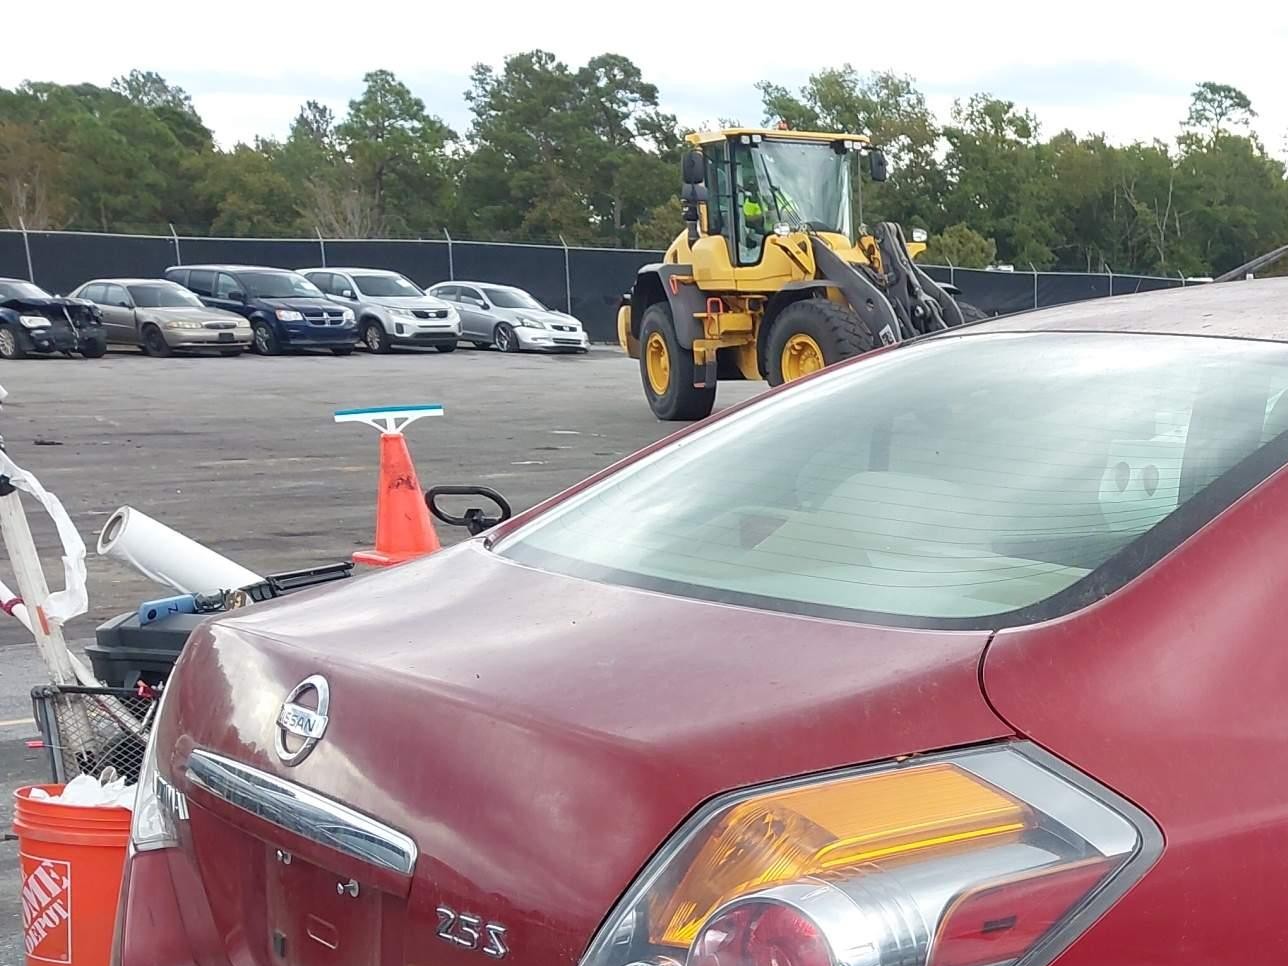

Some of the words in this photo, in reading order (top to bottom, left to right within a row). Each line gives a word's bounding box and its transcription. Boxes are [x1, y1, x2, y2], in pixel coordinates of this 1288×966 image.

[279, 706, 317, 732] SSAN
[21, 860, 69, 929] OME
[25, 899, 69, 955] DEPOT
[482, 921, 511, 959] S
